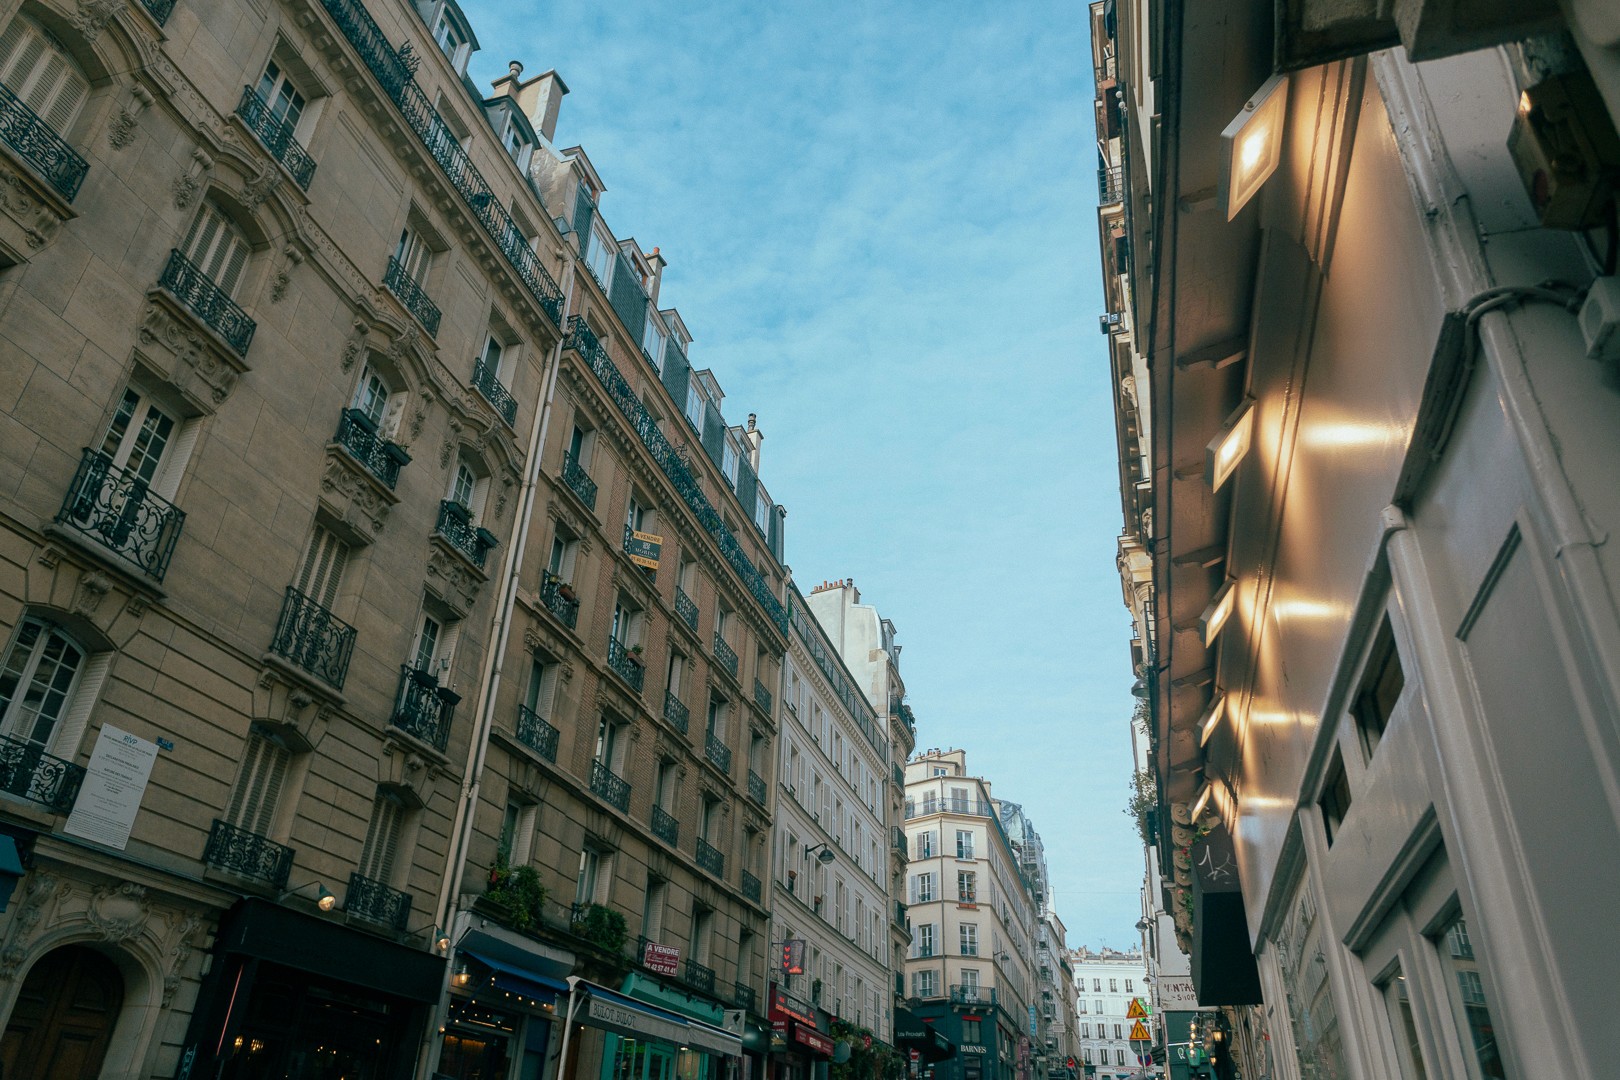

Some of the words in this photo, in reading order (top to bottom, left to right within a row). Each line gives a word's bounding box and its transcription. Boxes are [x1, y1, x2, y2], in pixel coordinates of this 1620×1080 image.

[654, 945, 680, 956] VENDRE
[1164, 983, 1195, 992] VINTAG
[593, 1003, 615, 1021] BULOT
[616, 1010, 636, 1027] BULOT
[960, 1044, 987, 1054] BARNES
